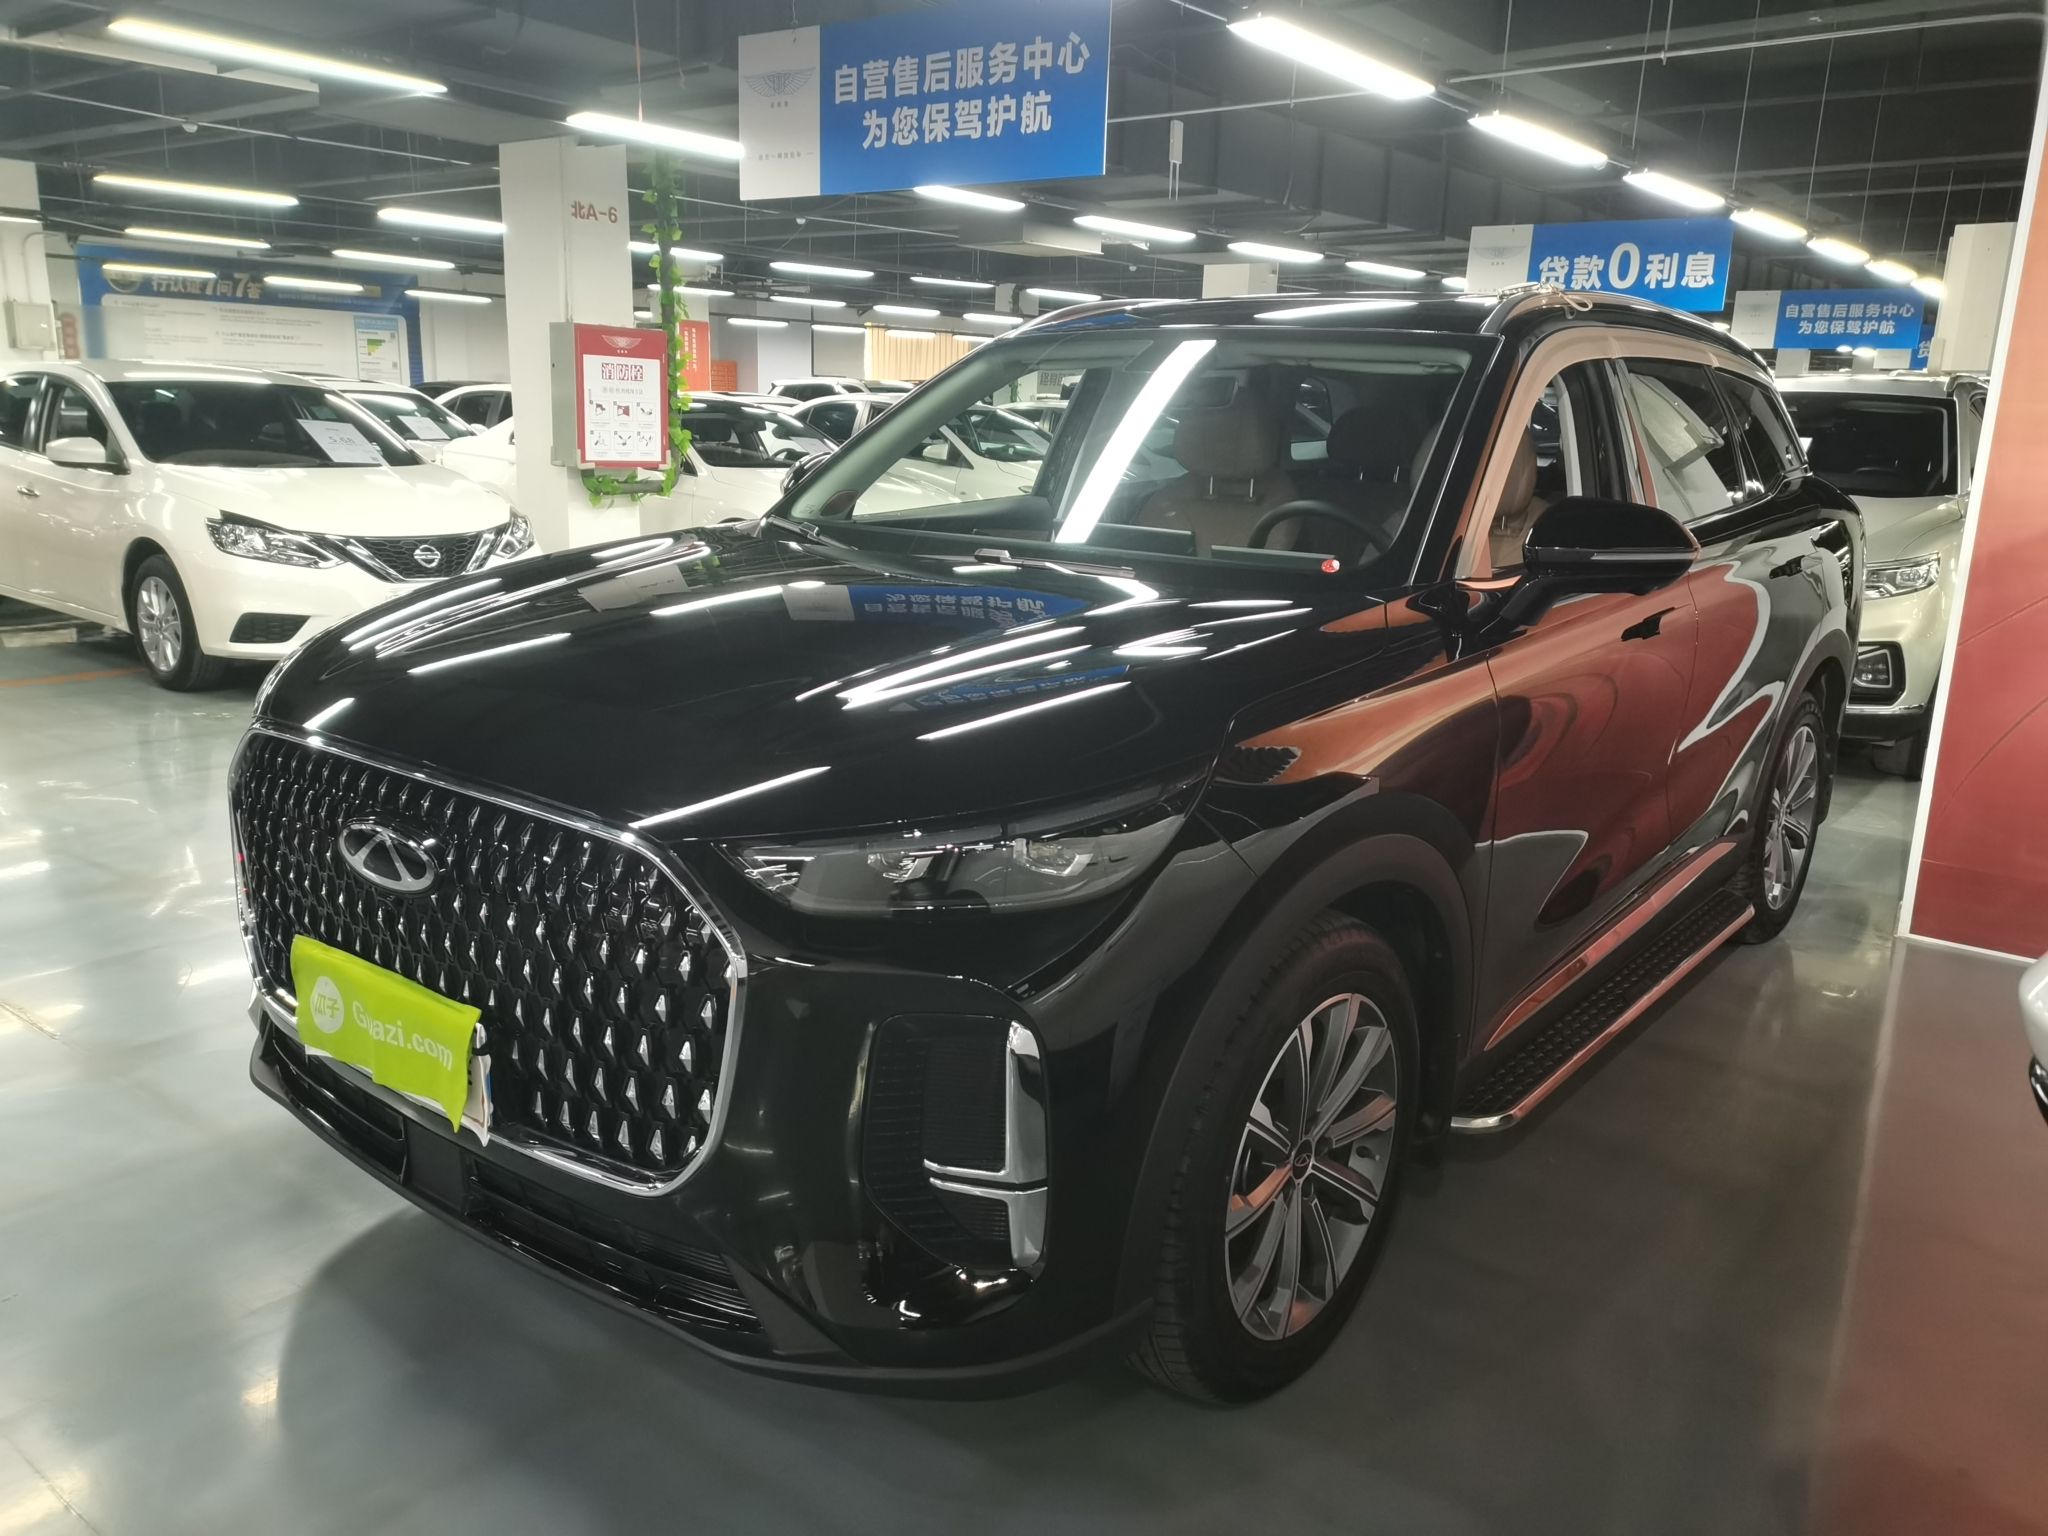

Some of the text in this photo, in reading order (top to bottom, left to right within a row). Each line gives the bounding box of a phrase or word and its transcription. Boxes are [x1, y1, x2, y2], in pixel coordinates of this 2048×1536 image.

[834, 31, 1091, 105] 自营售后服务中心
[861, 90, 1052, 150] 为您保驾护航
[570, 200, 618, 224] 北A-6
[1538, 242, 1716, 290] 贷款0利息
[1785, 303, 1915, 318] 自营售后服务中心
[1798, 319, 1896, 335] 为您保驾护航
[602, 362, 644, 382] 消防栓
[314, 993, 340, 1019] 瓜子
